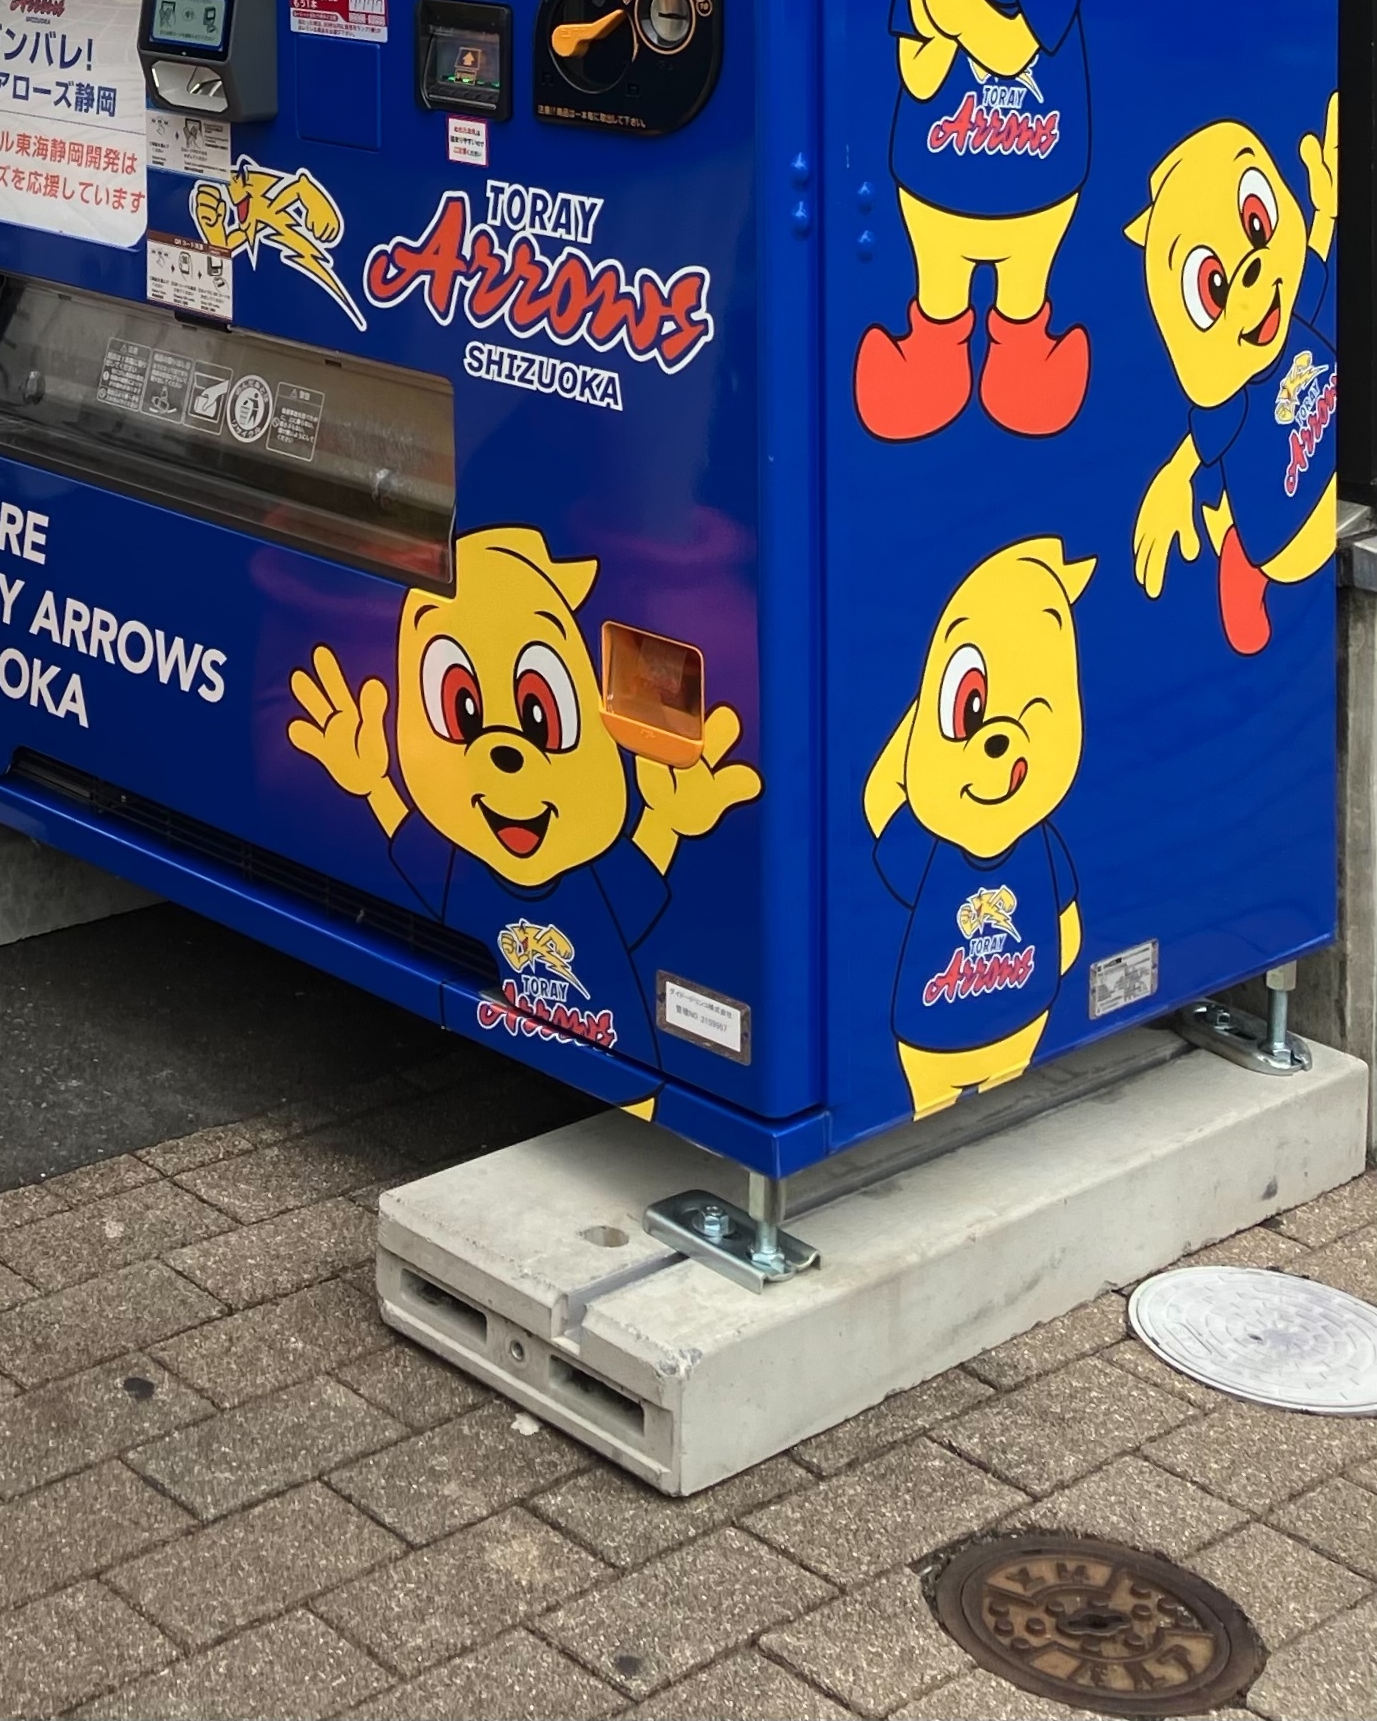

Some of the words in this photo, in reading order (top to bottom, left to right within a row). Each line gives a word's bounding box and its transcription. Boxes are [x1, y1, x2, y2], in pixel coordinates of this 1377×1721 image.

[927, 92, 1060, 159] Arrows
[983, 85, 1026, 108] TORAY
[487, 180, 603, 243] TORAY
[364, 191, 713, 374] Arrows
[463, 341, 622, 411] SHIZUOKA
[1295, 378, 1320, 427] TORAY
[29, 590, 227, 703] ARROWS
[923, 945, 1035, 1007] Arrows
[970, 934, 1007, 956] TORAY
[522, 974, 568, 1002] TORAY
